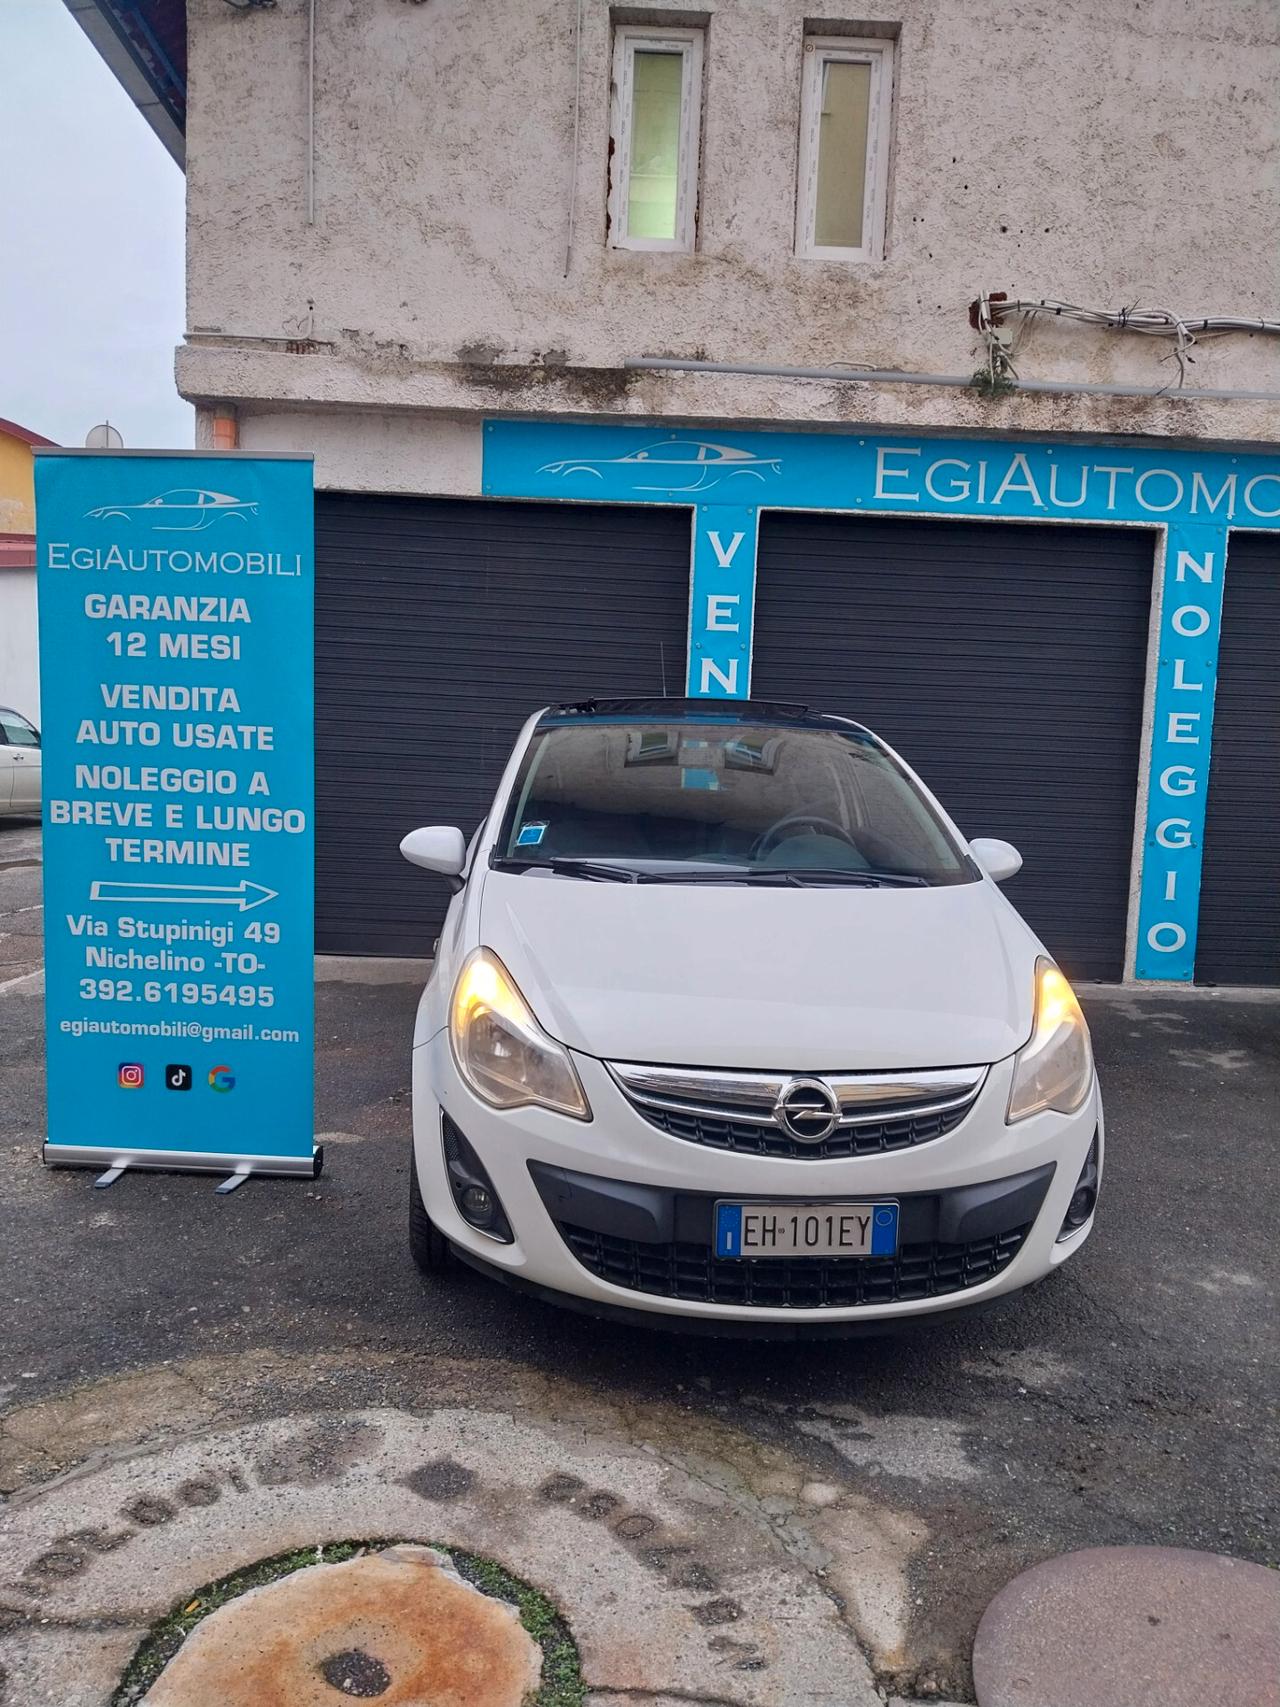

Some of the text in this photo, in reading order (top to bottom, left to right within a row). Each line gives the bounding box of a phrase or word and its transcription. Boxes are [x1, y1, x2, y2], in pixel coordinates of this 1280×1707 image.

[84, 593, 251, 623] GARANZIA
[106, 632, 240, 660] 12 MESI
[100, 684, 241, 713] VENDITA
[76, 720, 273, 751] AUTO USATE
[1147, 550, 1215, 953] NOLEGGIO
[75, 765, 270, 796] NOLEGGIO A
[50, 801, 306, 833] BREVE E LUNGO
[105, 837, 250, 867] TERMINE
[66, 915, 280, 947] Via Stupinigi 49
[86, 946, 266, 974] Nichelino -TO-
[79, 979, 274, 1007] 392.6195495
[60, 1018, 300, 1043] egiautomobili@gmail.com
